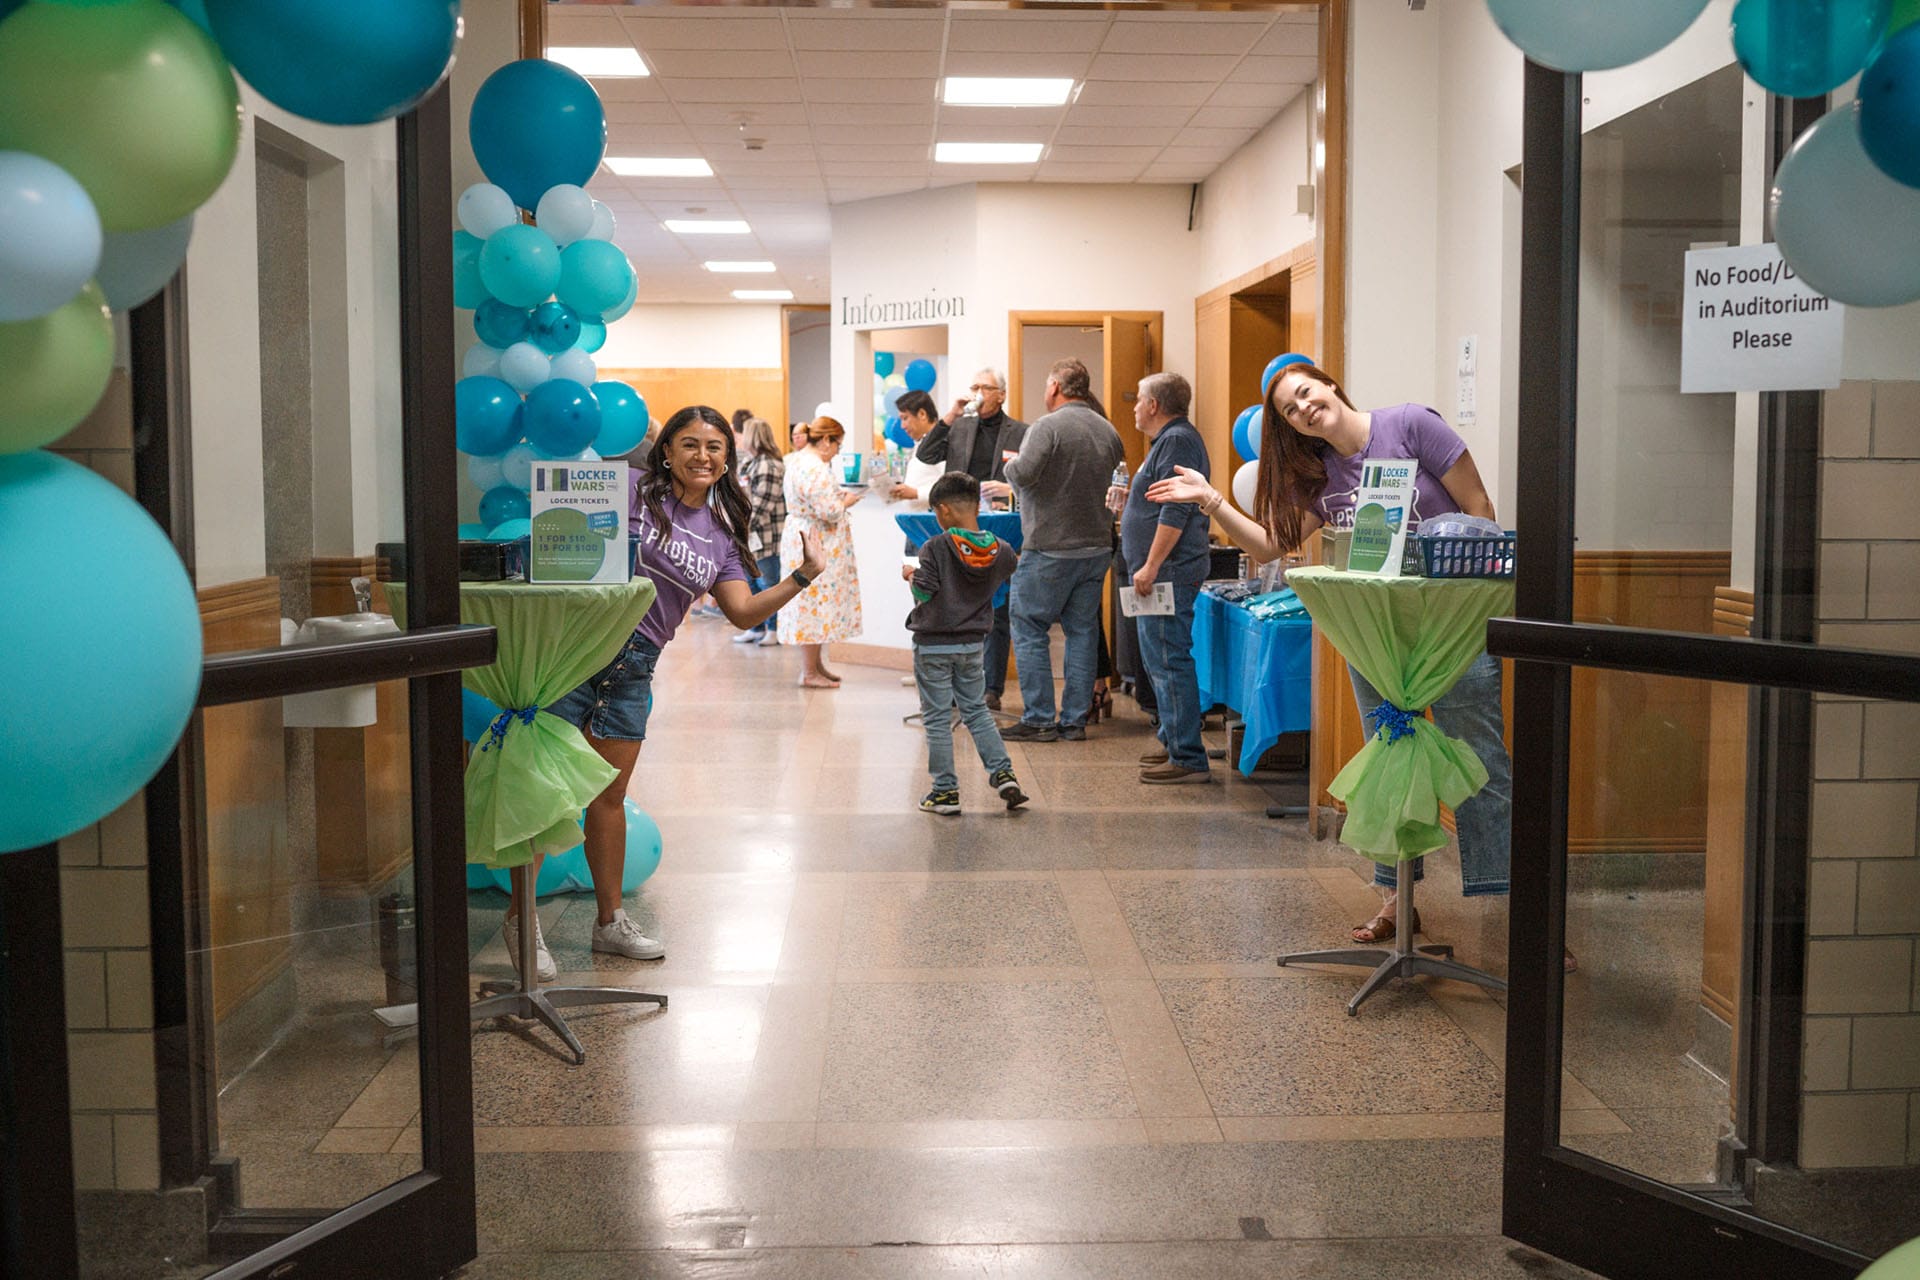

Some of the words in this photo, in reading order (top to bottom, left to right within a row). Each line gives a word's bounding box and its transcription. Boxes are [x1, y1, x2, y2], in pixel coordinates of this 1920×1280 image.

[1695, 269, 1721, 287] No
[1727, 260, 1796, 285] Food/D
[842, 288, 965, 325] Information
[1699, 301, 1715, 319] in
[1721, 294, 1829, 317] Auditorium
[1733, 330, 1793, 349] Please
[571, 470, 616, 480] LOCKER
[1383, 468, 1408, 477] LOCKER
[571, 481, 605, 491] WARS
[1382, 479, 1400, 488] WARS
